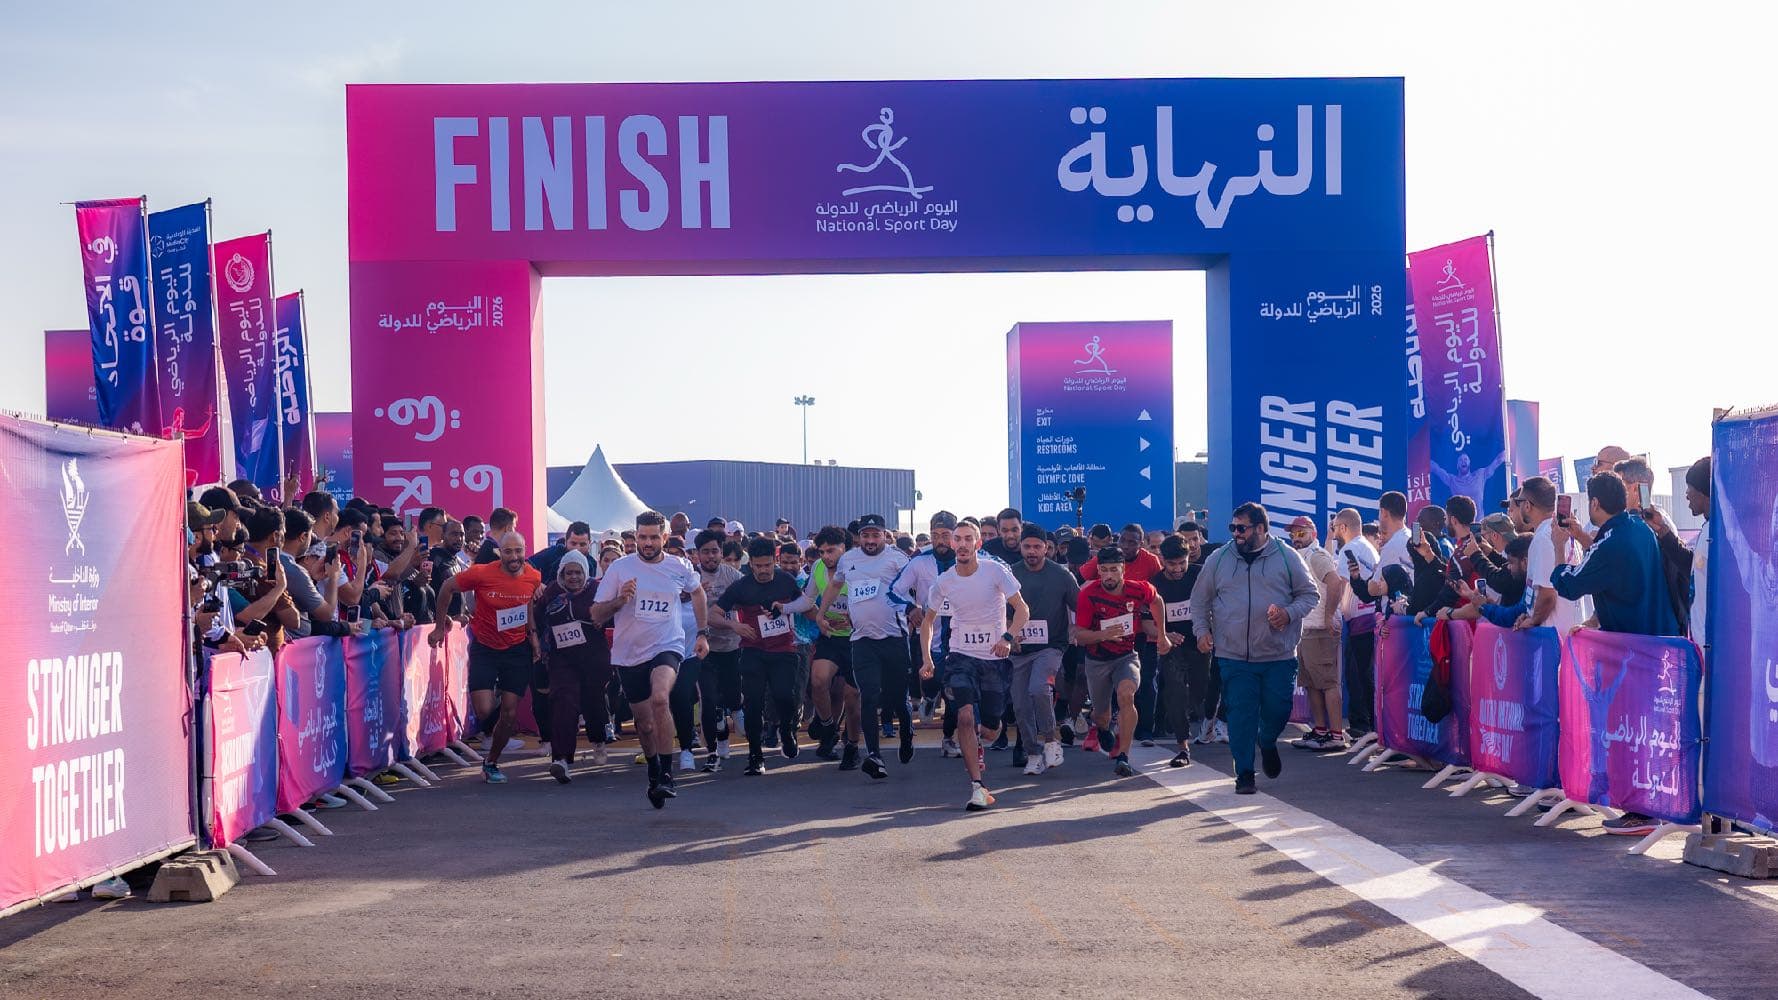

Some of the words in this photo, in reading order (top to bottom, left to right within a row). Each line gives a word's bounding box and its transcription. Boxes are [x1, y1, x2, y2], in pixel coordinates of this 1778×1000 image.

[433, 113, 731, 232] FINISH
[1057, 104, 1342, 229] النهاية
[815, 202, 859, 218] للدولة
[864, 201, 918, 219] الرياضي
[924, 200, 958, 215] اليوم
[816, 219, 880, 232] National
[884, 219, 926, 234] Sport
[930, 218, 958, 232] Day
[161, 267, 180, 315] اليوم
[1307, 285, 1360, 306] اليوم
[1371, 284, 1382, 316] 2026
[179, 262, 197, 343] للدولة
[426, 296, 482, 316] اليوم
[492, 296, 504, 327] 2026
[1260, 302, 1302, 320] للدولة
[1307, 301, 1360, 323] الرياضي
[230, 301, 254, 341] اليوم
[378, 314, 422, 332] للدولة
[426, 313, 482, 334] الرياضي
[249, 298, 268, 367] للدولة
[1434, 312, 1463, 363] اليوم
[164, 322, 184, 397] الرياضي
[1461, 307, 1487, 394] للدولة
[374, 396, 461, 442] في
[1036, 417, 1052, 427] EXIT
[1443, 371, 1471, 451] الرياضي
[1036, 444, 1078, 455] RESTROOMS
[1037, 474, 1067, 484] OLYMPIC
[1068, 473, 1086, 483] ZONE
[1038, 502, 1054, 513] KIDS
[1055, 502, 1073, 512] AREA
[854, 586, 877, 597] 1499
[48, 593, 72, 616] Ministry
[72, 593, 80, 612] of
[80, 594, 99, 611] Interior
[640, 600, 669, 613] 1712
[501, 612, 525, 625] 1046
[763, 620, 786, 632] 1394
[556, 629, 581, 642] 1130
[964, 633, 991, 643] 1157
[27, 651, 123, 752] STRONGER
[1600, 714, 1647, 757] الرياضي
[1649, 721, 1681, 758] اليوم
[1632, 759, 1681, 800] للدولة
[32, 747, 127, 858] TOGETHER
